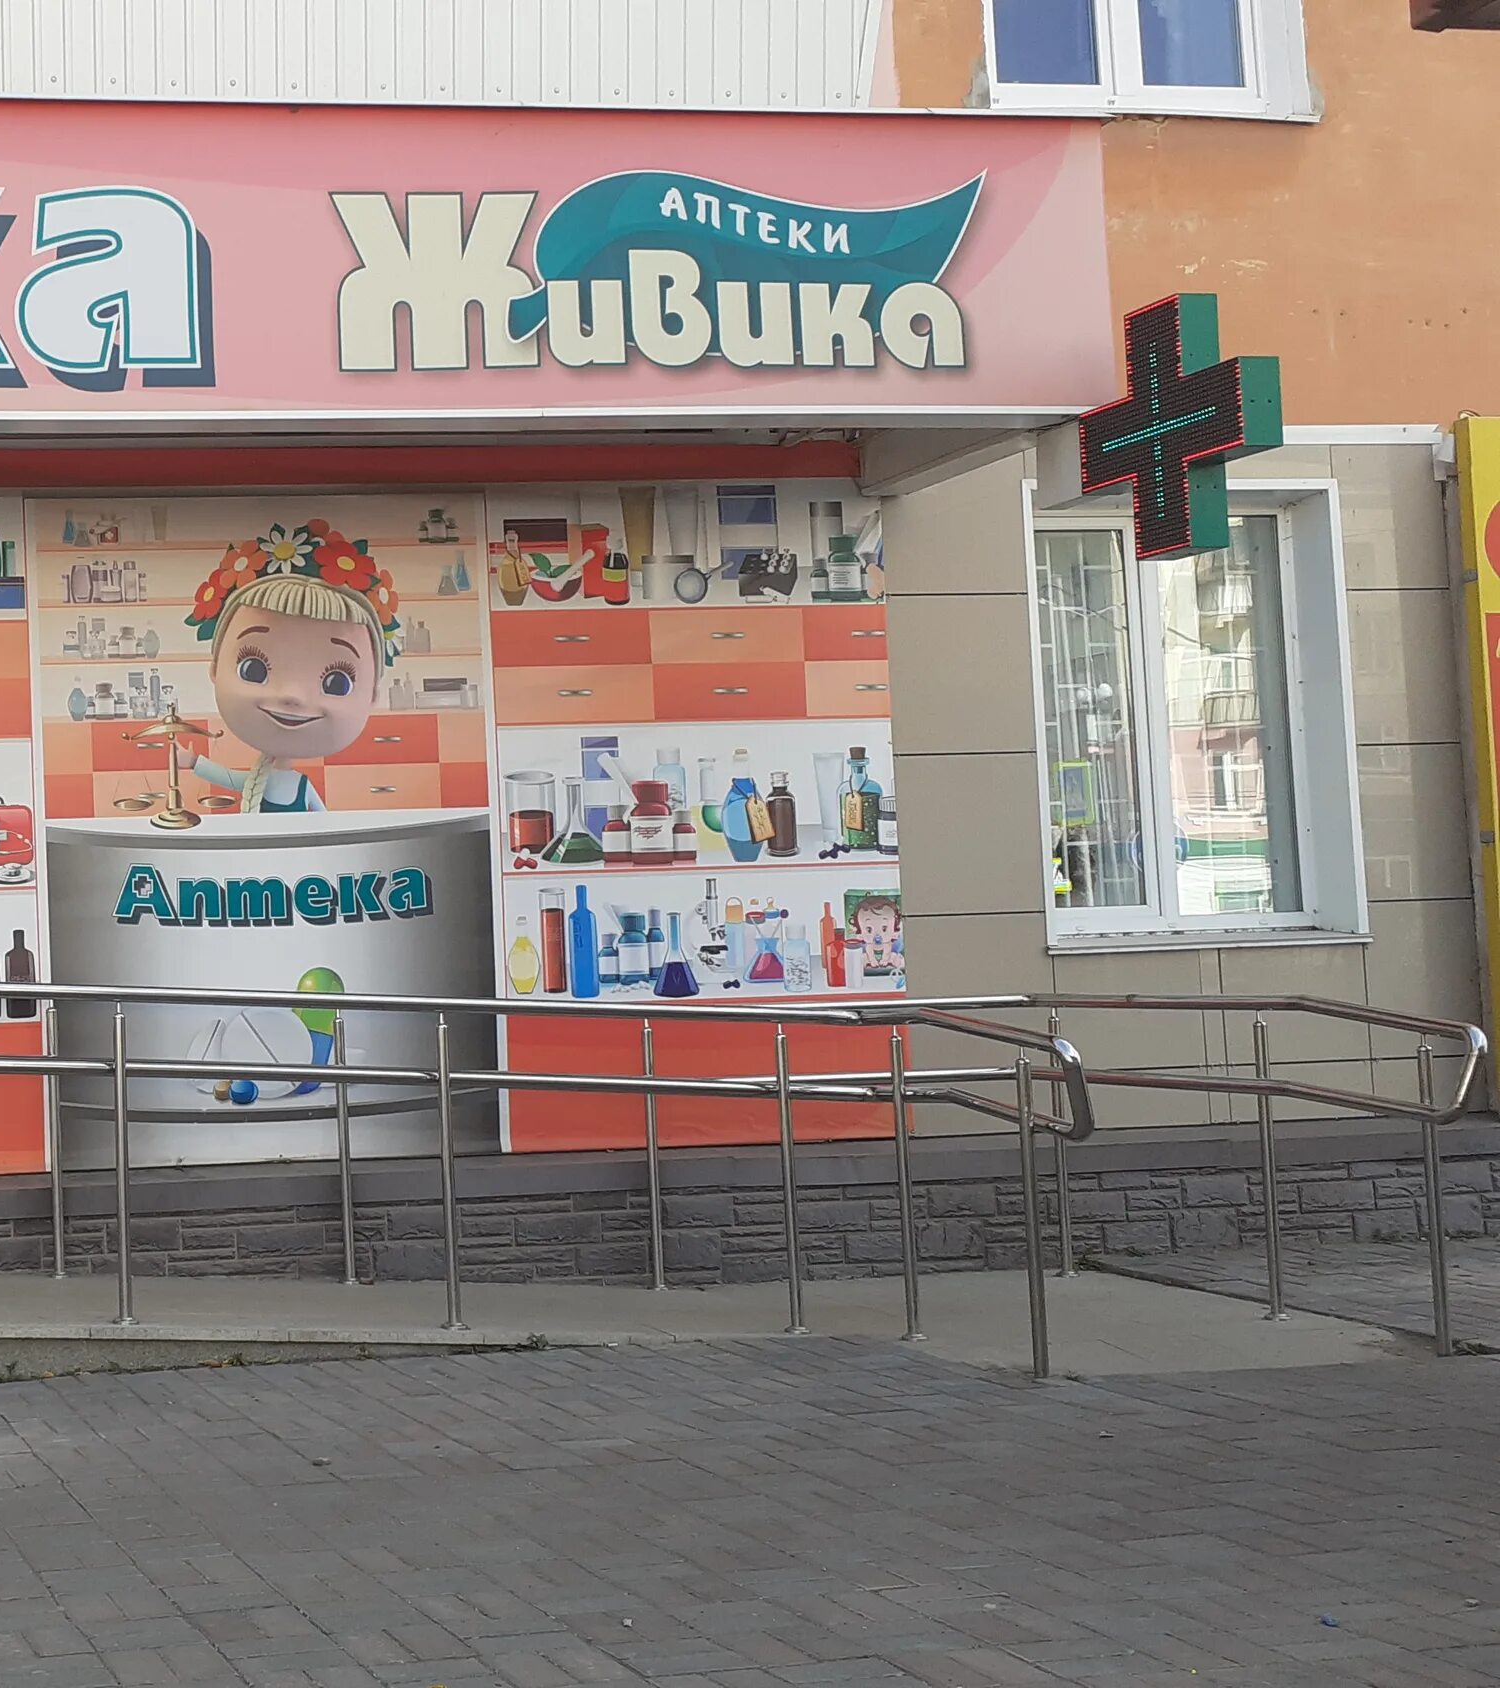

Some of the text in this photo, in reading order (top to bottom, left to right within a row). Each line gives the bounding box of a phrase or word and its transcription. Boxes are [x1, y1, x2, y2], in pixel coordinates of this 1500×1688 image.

[659, 186, 851, 255] АПТЕКИ
[328, 190, 967, 372] Живика
[112, 863, 431, 926] Аптека
